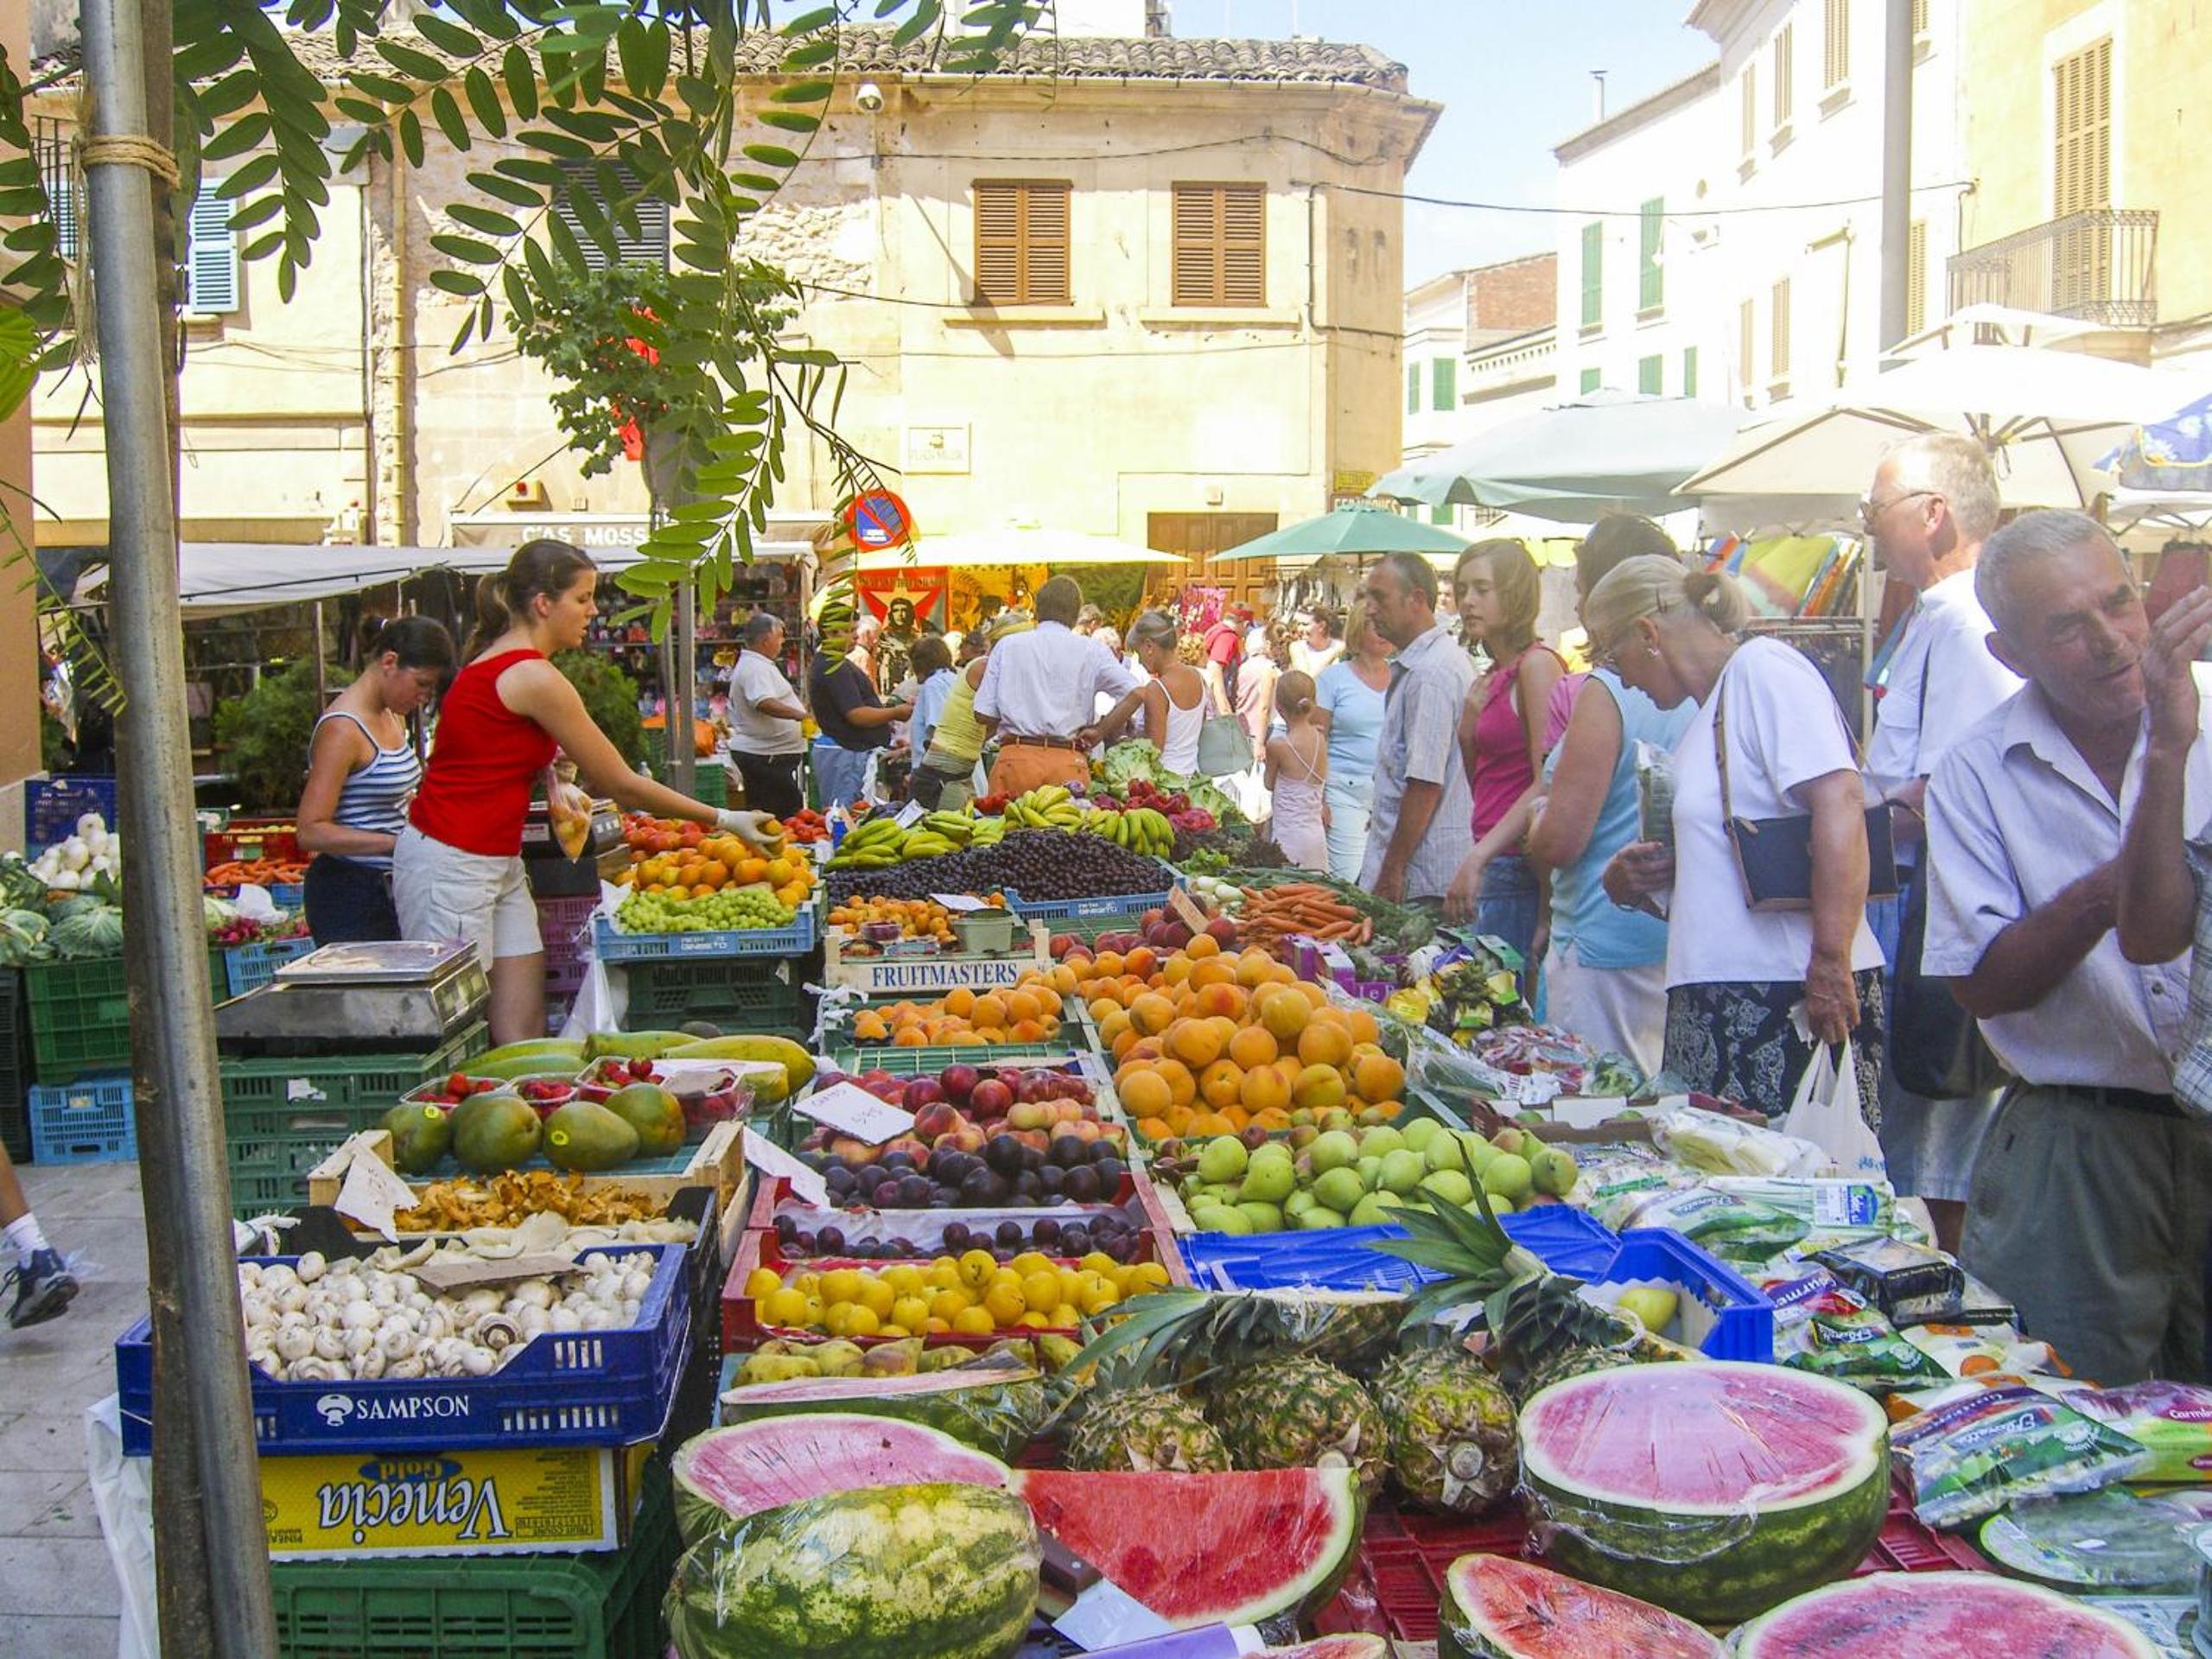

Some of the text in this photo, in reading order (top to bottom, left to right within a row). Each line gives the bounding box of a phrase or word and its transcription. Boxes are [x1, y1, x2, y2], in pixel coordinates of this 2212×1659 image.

[872, 963, 1018, 988] FRUITMASTERS
[357, 1395, 470, 1420] SAMPSON
[378, 1460, 442, 1482] Gold
[316, 1476, 513, 1546] Venecia
[270, 1534, 303, 1544] PINEA
